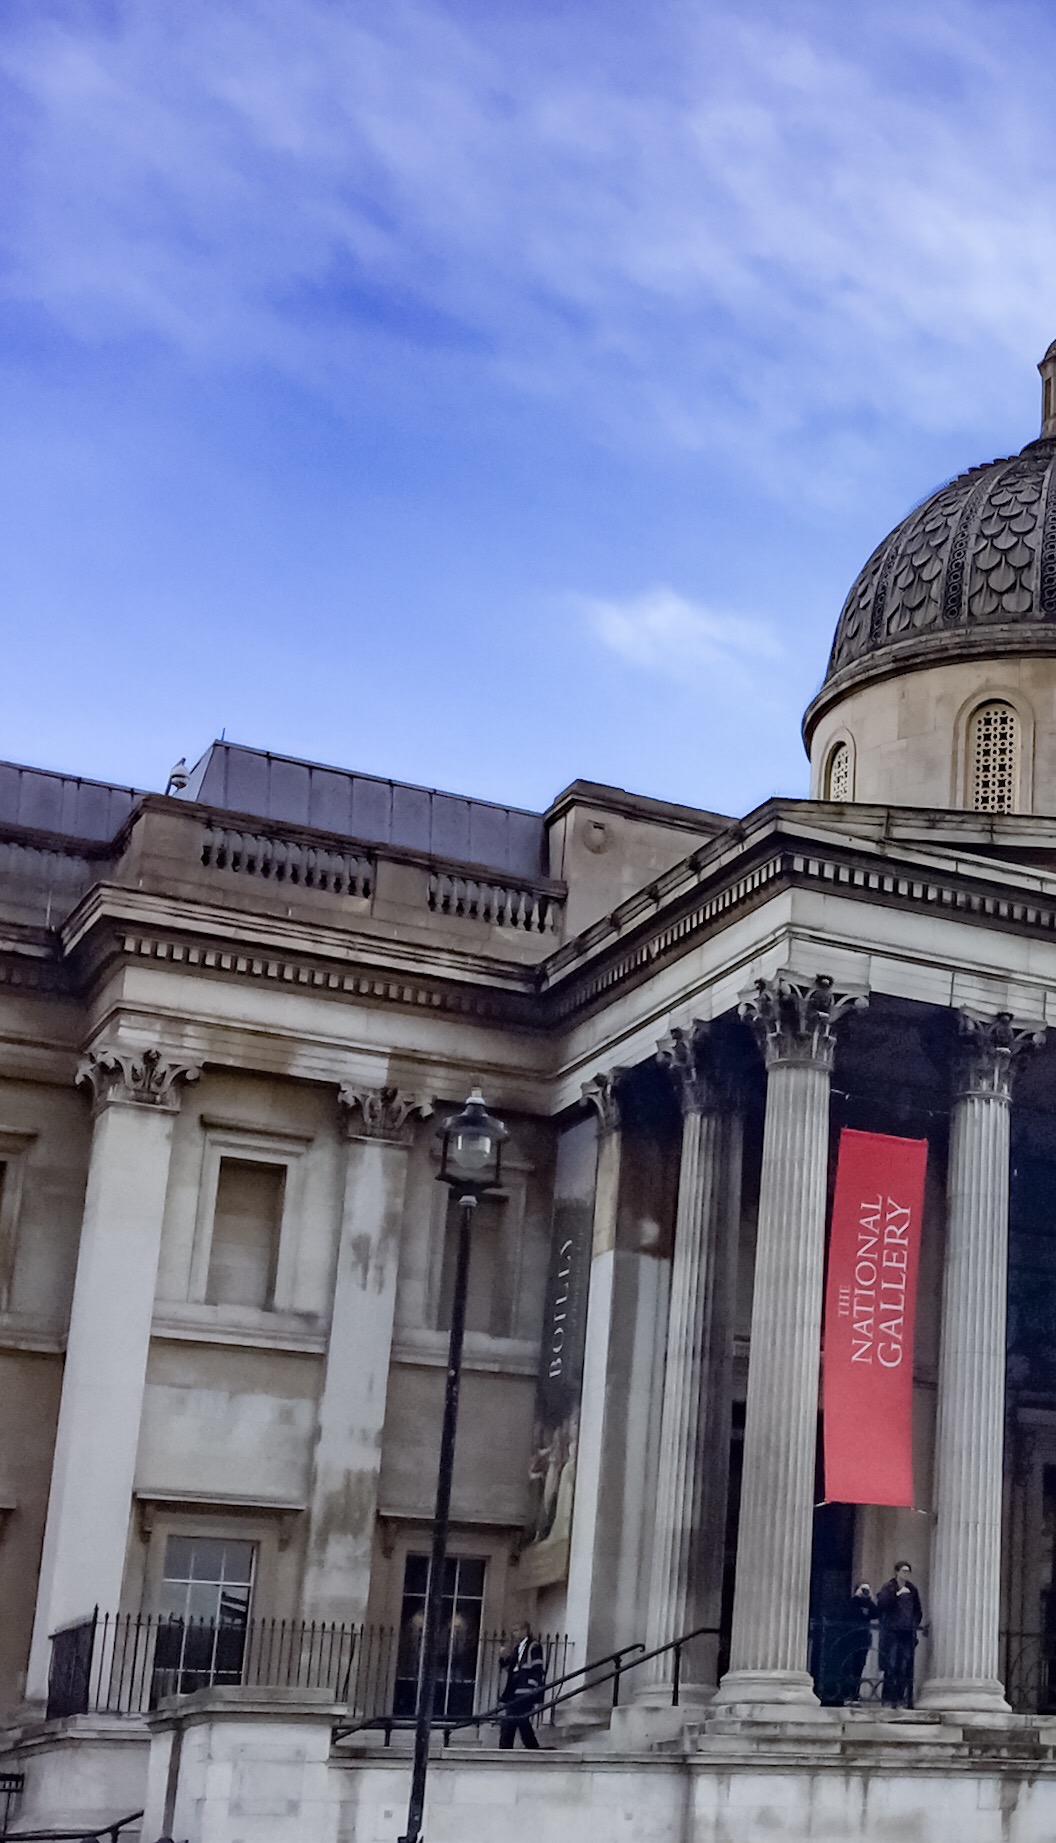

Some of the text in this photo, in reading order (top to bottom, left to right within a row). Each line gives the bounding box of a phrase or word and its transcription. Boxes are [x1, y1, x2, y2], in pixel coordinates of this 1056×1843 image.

[838, 1284, 850, 1318] THE
[851, 1194, 883, 1364] NATIONAL
[877, 1195, 912, 1368] GALLERY
